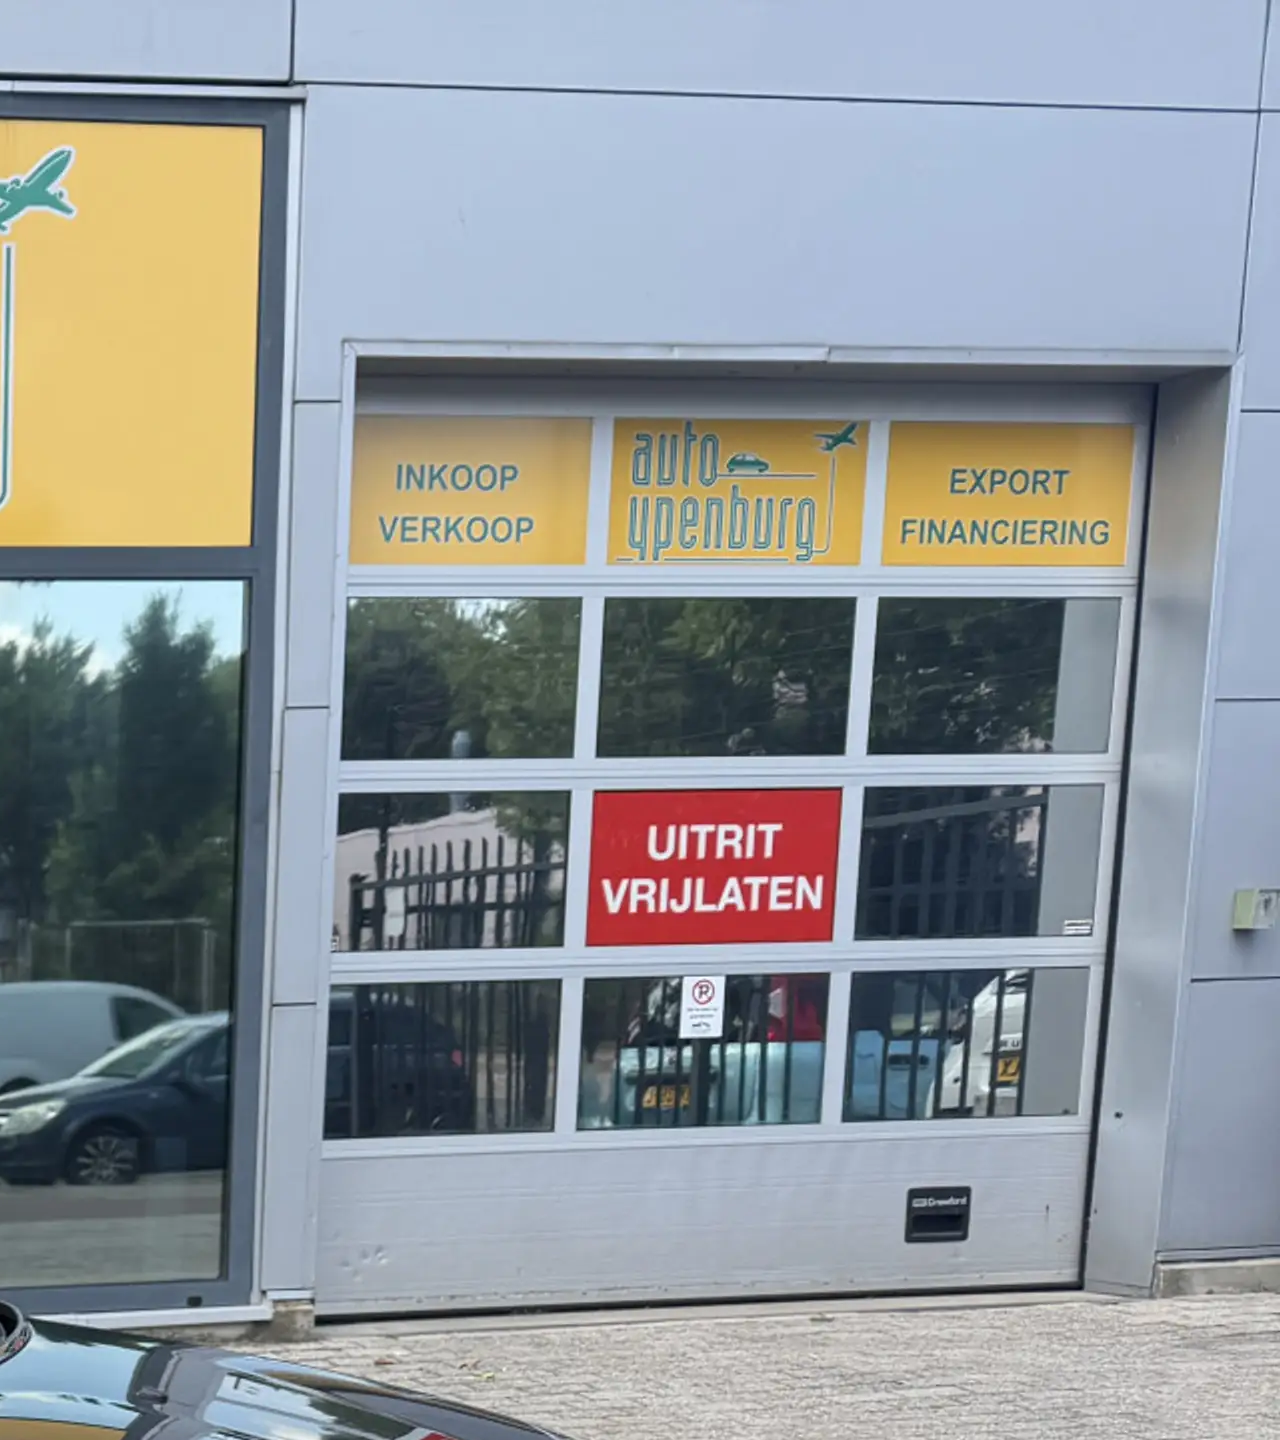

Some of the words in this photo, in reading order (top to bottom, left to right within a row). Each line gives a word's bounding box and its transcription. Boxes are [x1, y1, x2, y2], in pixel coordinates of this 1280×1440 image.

[631, 420, 721, 488] auto
[396, 463, 519, 493] INKOOP
[948, 467, 1070, 497] EXPORT
[379, 516, 535, 544] VERKOOP
[628, 485, 818, 562] ypenburg
[901, 518, 1111, 547] FINANCIERING
[647, 823, 784, 862] UITRIT
[602, 875, 824, 915] VRIJLATEN
